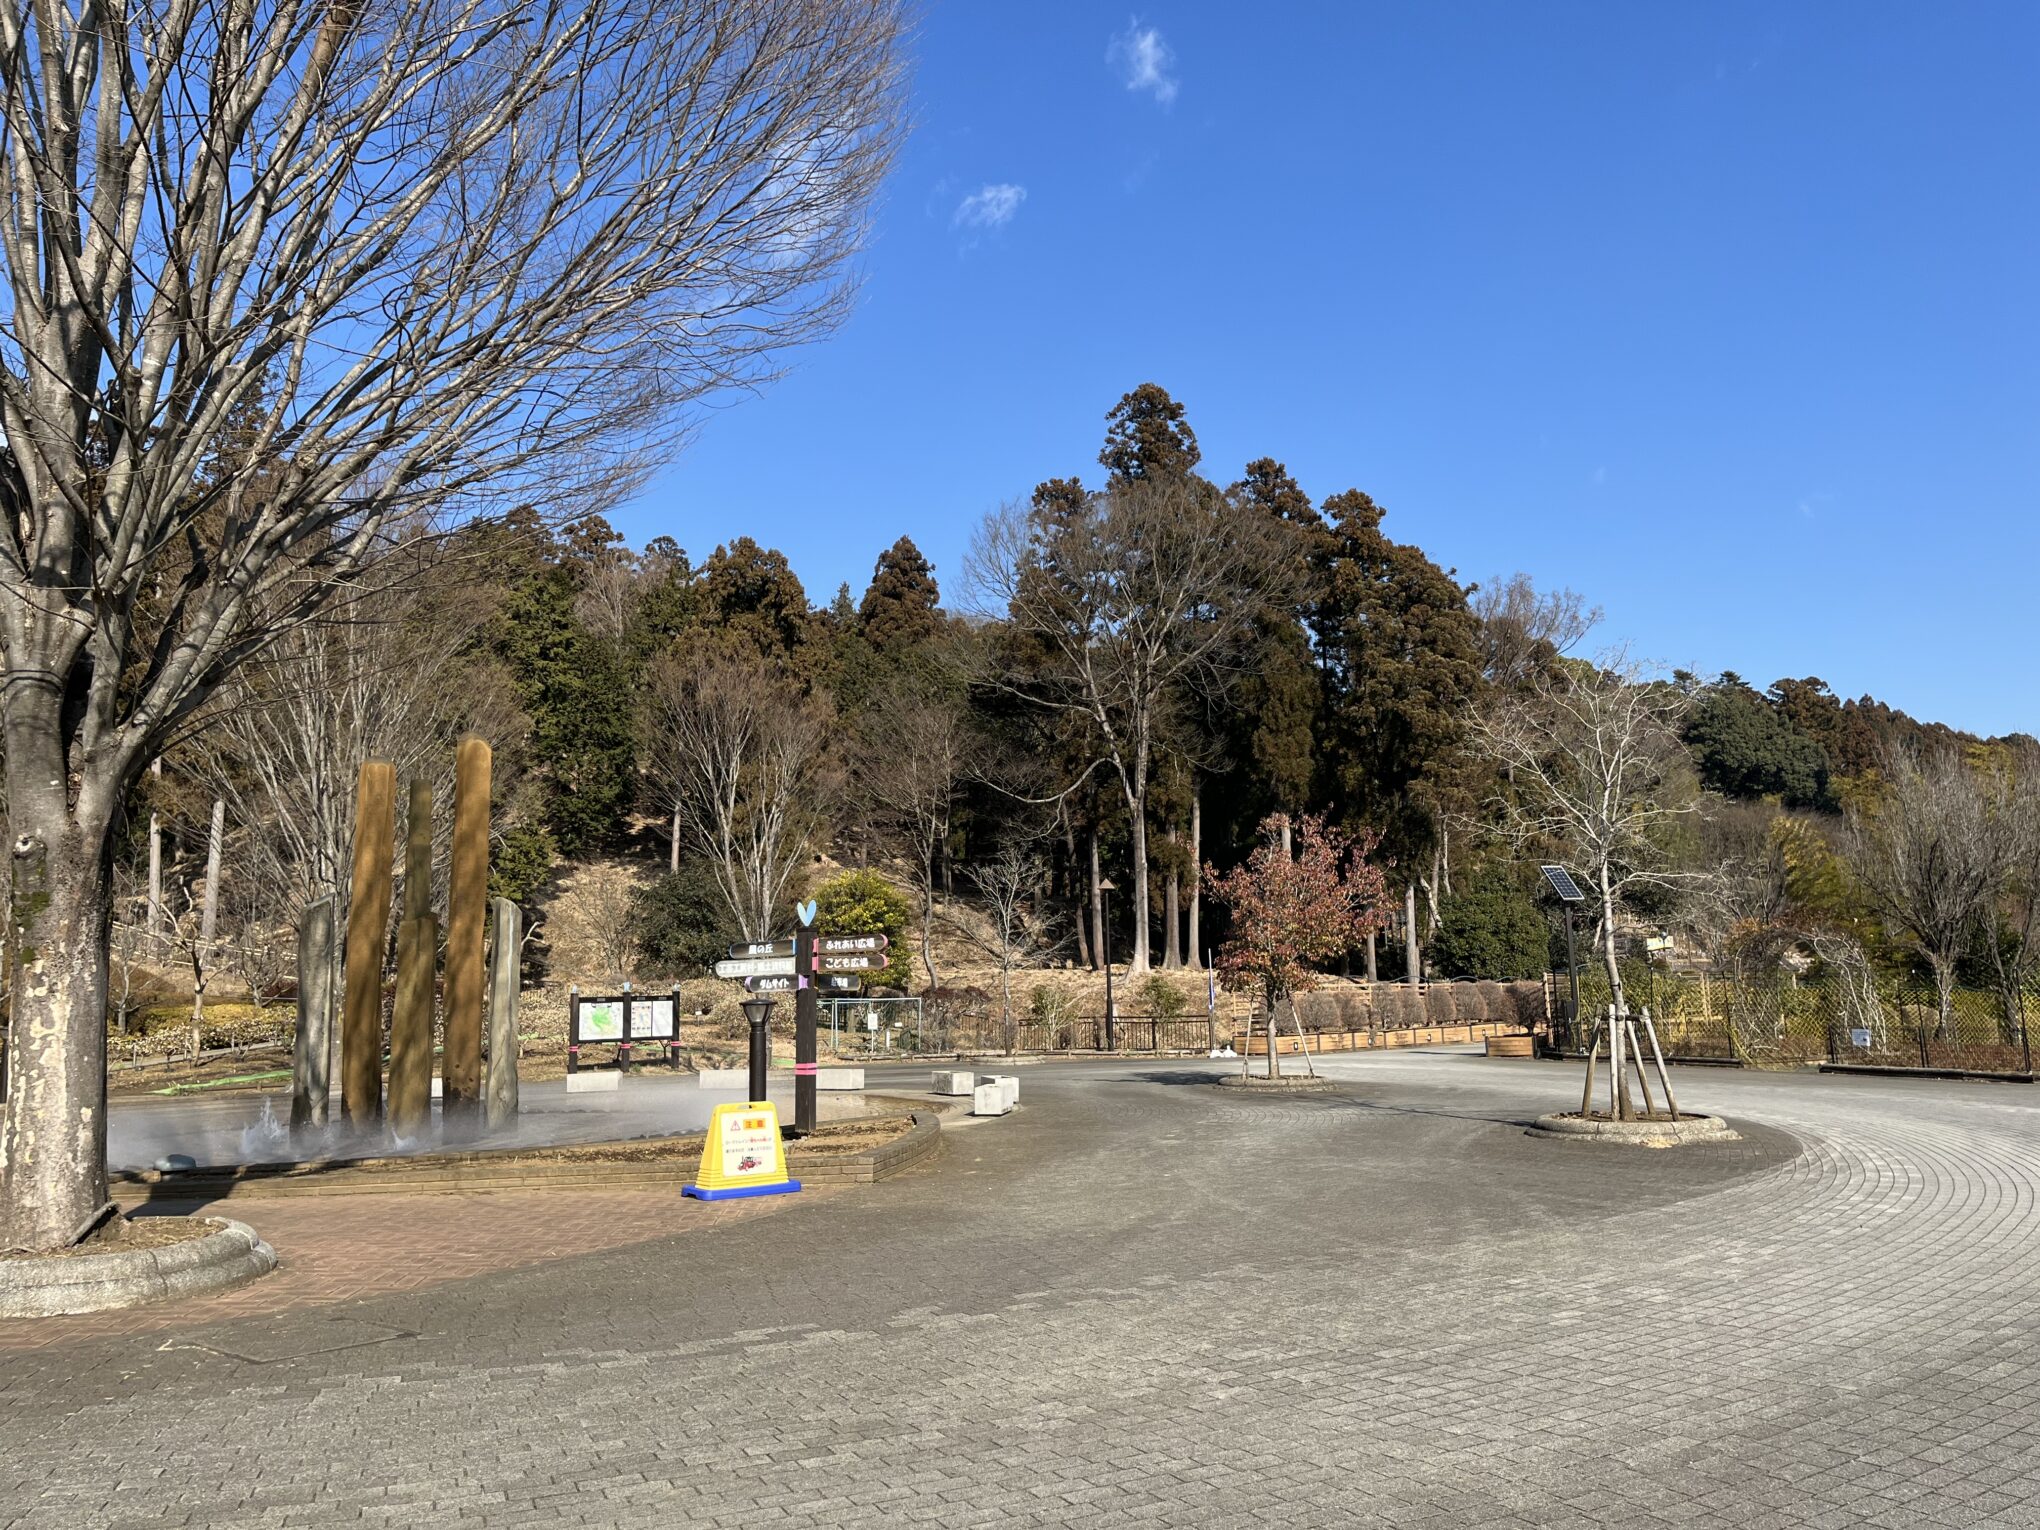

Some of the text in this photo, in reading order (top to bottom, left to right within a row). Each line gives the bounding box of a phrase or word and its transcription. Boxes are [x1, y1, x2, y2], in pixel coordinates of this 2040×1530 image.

[826, 938, 875, 950] ふれあい広場
[825, 957, 869, 968] こども広場
[760, 978, 790, 989] ダムサイト
